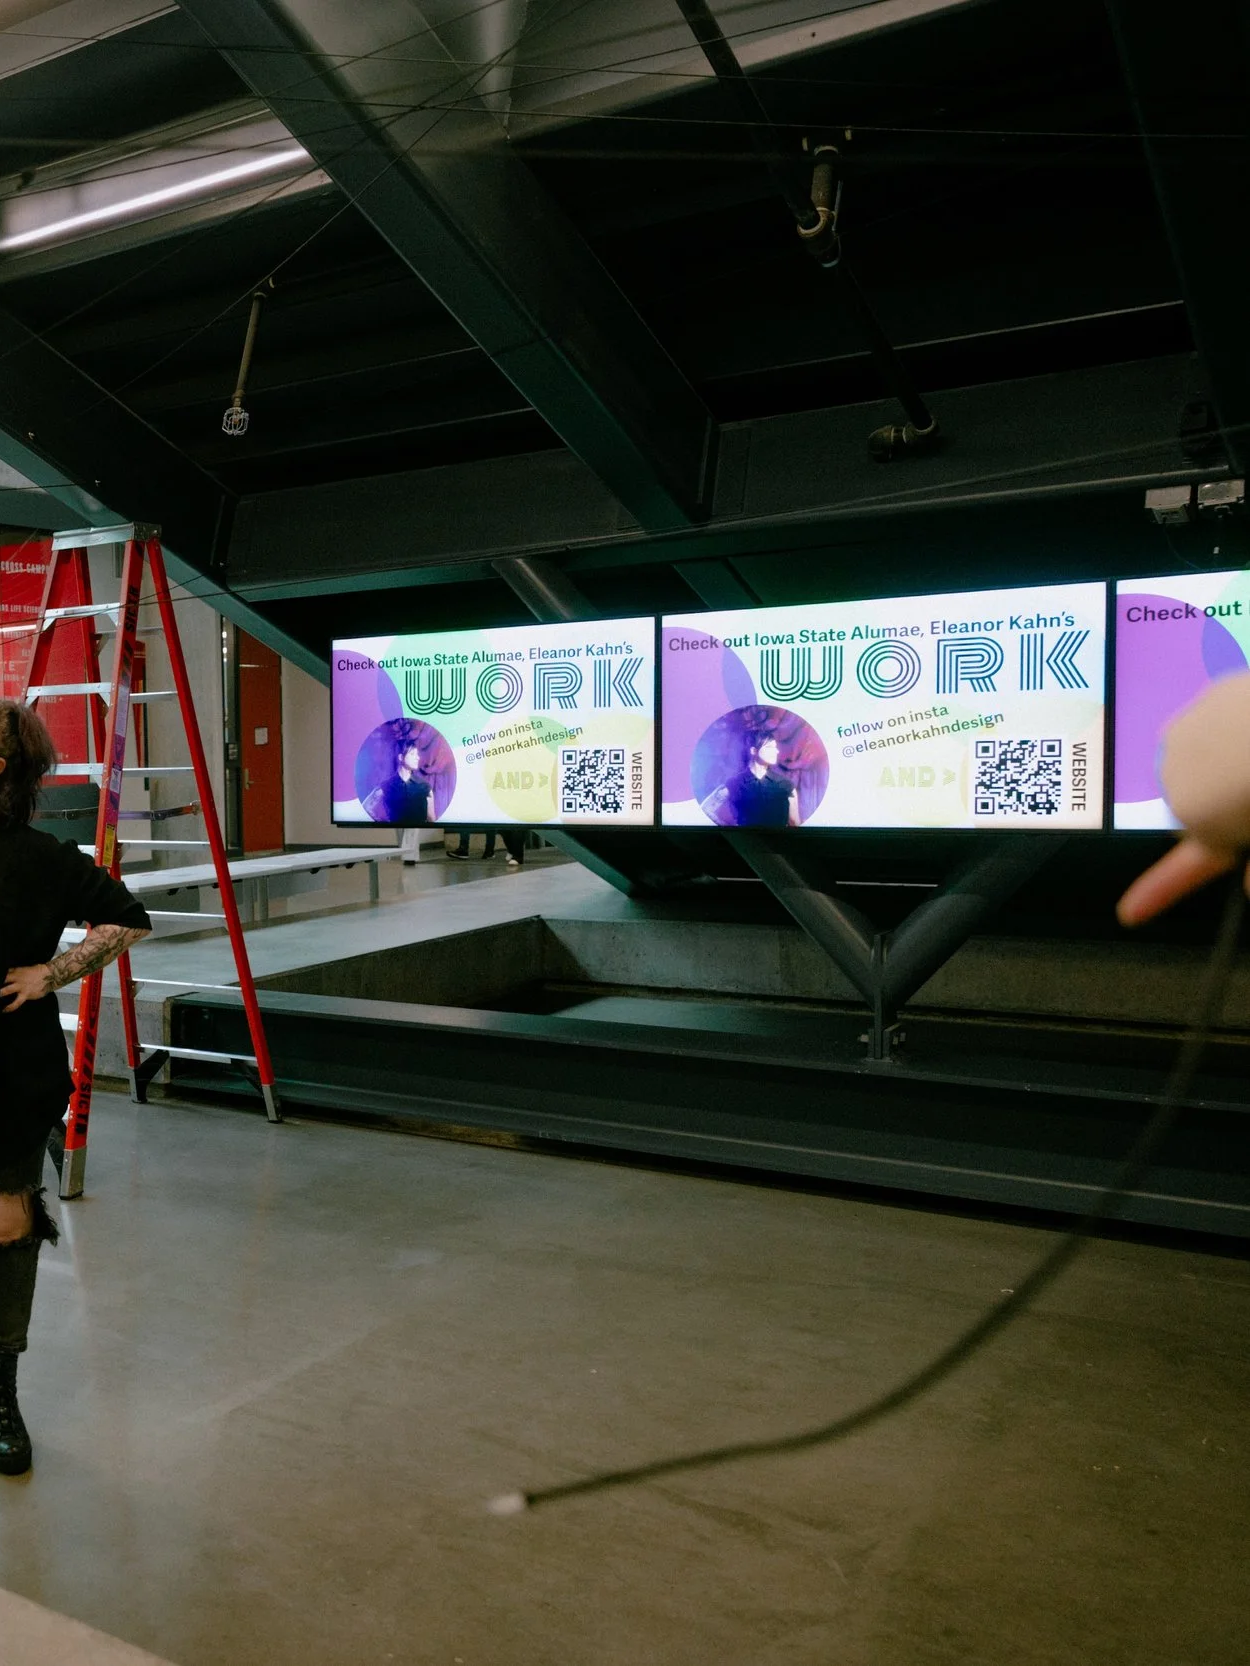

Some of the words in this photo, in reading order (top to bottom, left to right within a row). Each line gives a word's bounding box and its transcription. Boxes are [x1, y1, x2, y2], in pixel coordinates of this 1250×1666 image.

[26, 563, 50, 575] CAMP
[1126, 603, 1197, 622] Check
[1204, 601, 1242, 617] out
[669, 635, 719, 651] Check
[723, 634, 750, 648] out
[755, 633, 795, 646] Iowa
[799, 628, 846, 643] State
[851, 625, 925, 640] Alumae,
[930, 619, 1004, 635] Eleanor
[1009, 611, 1075, 630] Kahn's
[337, 658, 375, 671] Check
[378, 658, 398, 669] out
[401, 656, 431, 668] Iowa
[434, 653, 468, 665] State
[471, 649, 525, 663] Alumae,
[529, 646, 583, 660] Eleanor
[586, 641, 633, 657] Kahn's
[760, 630, 1090, 701] WORK
[405, 657, 644, 715] WORK
[462, 731, 496, 747] follow
[498, 728, 513, 739] on
[514, 720, 544, 734] insta
[837, 719, 884, 738] follow
[887, 715, 907, 728] on
[909, 705, 950, 723] insta
[842, 711, 1005, 758] @eleanorkahndesign
[465, 726, 584, 764] @eleanorkahndesign
[492, 771, 535, 790] AND
[631, 751, 643, 810] WEBSITE
[879, 766, 936, 788] AND
[1072, 741, 1087, 812] WEBSITE
